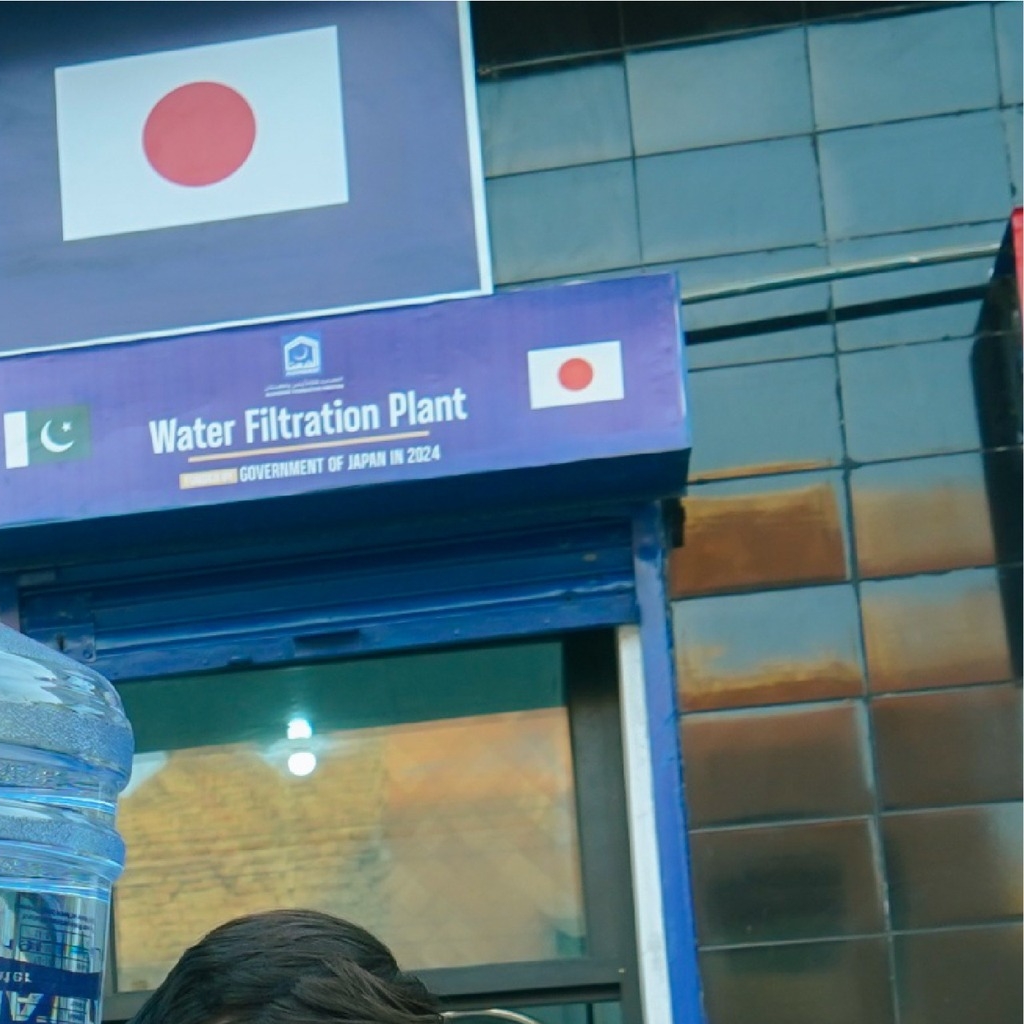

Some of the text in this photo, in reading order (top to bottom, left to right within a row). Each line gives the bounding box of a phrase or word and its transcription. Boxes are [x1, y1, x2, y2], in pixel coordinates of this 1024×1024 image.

[149, 387, 468, 454] Water Filtration Plant
[239, 457, 324, 483] GOVERNMENT
[328, 455, 345, 472] OF
[348, 451, 386, 471] JAPAN
[390, 448, 404, 466] IN
[407, 445, 441, 463] 2024
